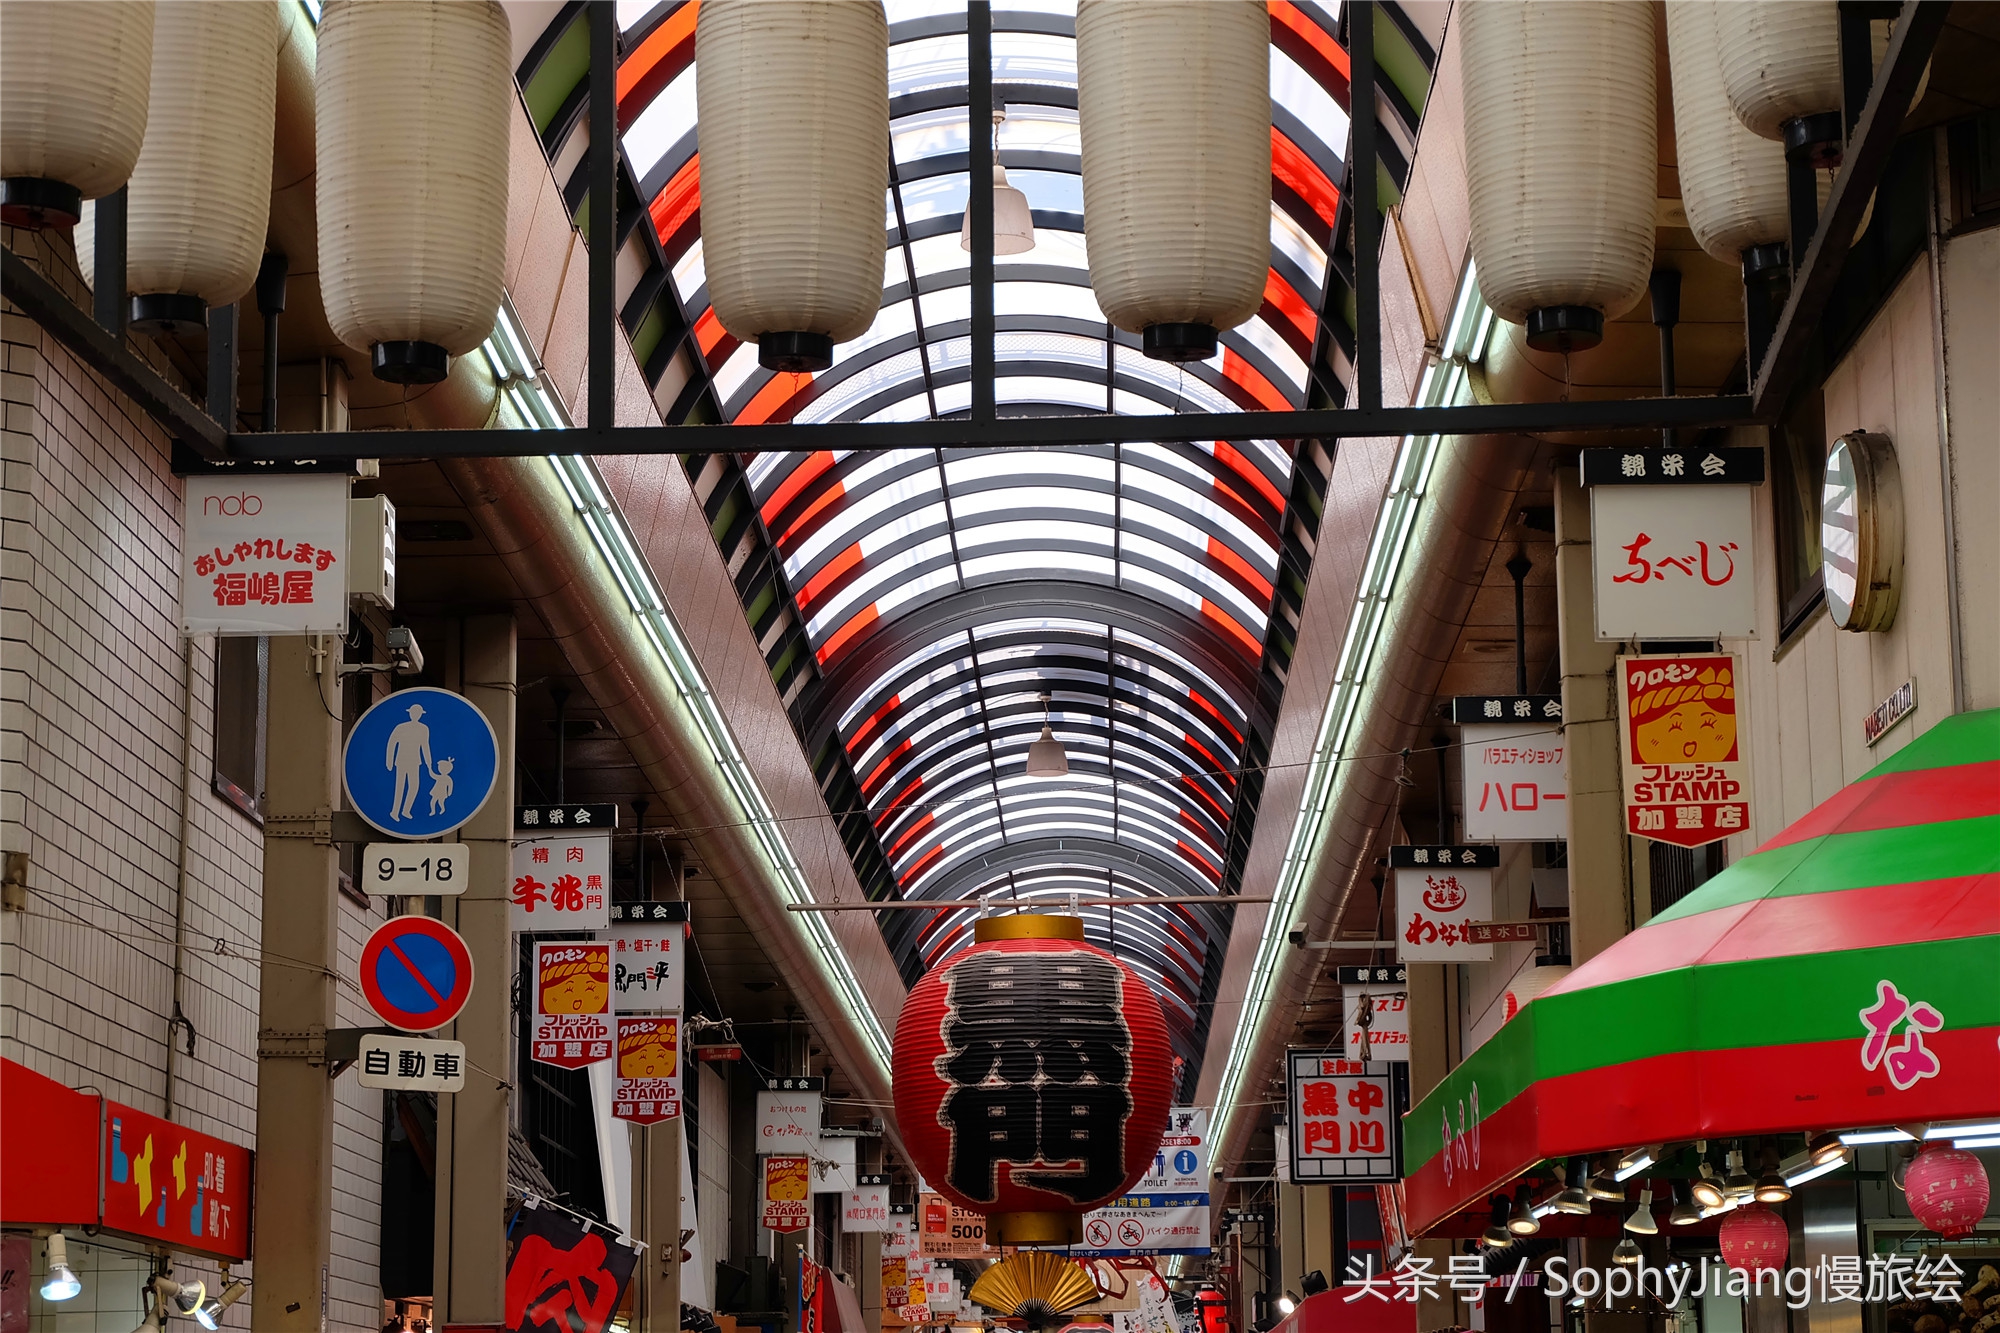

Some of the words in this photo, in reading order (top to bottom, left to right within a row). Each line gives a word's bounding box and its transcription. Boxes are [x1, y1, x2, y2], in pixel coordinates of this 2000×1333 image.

[1621, 453, 1726, 477] 親栄会
[204, 491, 263, 516] nob
[193, 538, 336, 576] おしゃれします
[213, 571, 314, 606] 福嶋屋
[1630, 664, 1698, 691] クロモン
[1484, 700, 1562, 717] 親栄会
[1484, 748, 1563, 764] バラエティショップ
[1642, 764, 1726, 781] フレッシュ
[1479, 782, 1566, 811] ハロー
[1634, 781, 1740, 803] STAMP
[523, 808, 591, 824] 親栄会
[1637, 806, 1742, 830] 加盟店
[532, 847, 584, 863] 精肉
[1414, 849, 1477, 864] 親栄会
[586, 875, 603, 910] 黒門
[609, 905, 668, 919] 親栄会
[1478, 925, 1529, 940] 送水口
[609, 939, 670, 952] 魚・塩干・鮭
[542, 948, 587, 966] クロモン
[1357, 969, 1407, 981] 親栄会
[1371, 1000, 1406, 1012] スリ
[544, 1015, 600, 1026] フレッシュ
[538, 1026, 608, 1039] STAMP
[619, 1021, 657, 1037] クロモン
[538, 1042, 608, 1057] 加盟店
[364, 1048, 460, 1080] 自動車
[622, 1079, 669, 1088] フレッシュ
[617, 1088, 676, 1099] STAMP
[617, 1102, 676, 1115] 加盟店
[768, 1160, 795, 1170] クロモン
[766, 1207, 807, 1215] STAMP
[766, 1217, 807, 1227] 加盟店
[951, 1225, 983, 1238] 500
[1147, 1227, 1200, 1235] バイク通行禁止
[902, 1308, 928, 1316] STAMP
